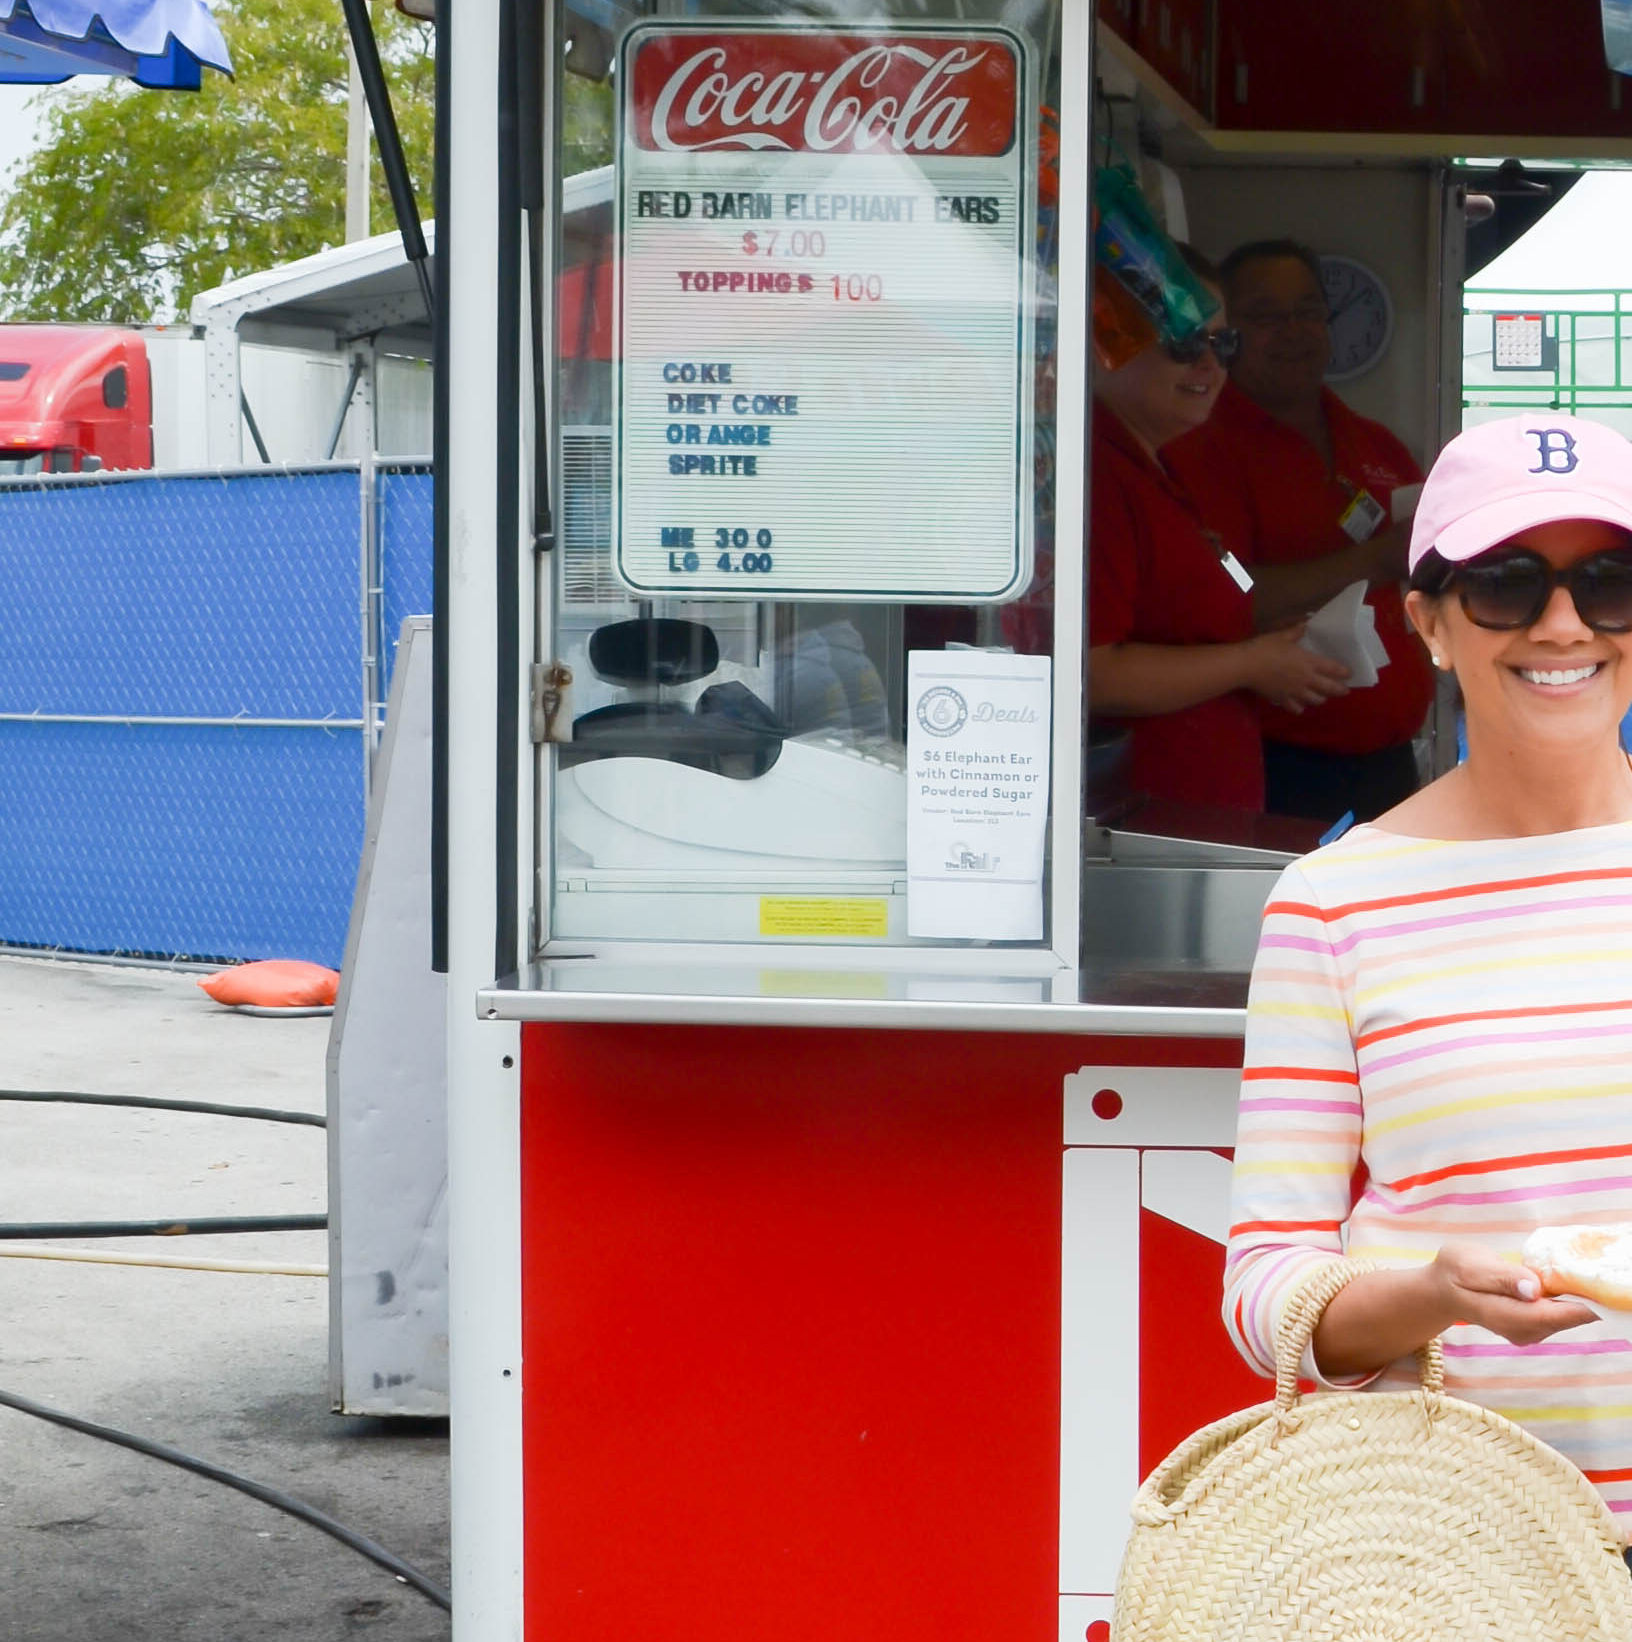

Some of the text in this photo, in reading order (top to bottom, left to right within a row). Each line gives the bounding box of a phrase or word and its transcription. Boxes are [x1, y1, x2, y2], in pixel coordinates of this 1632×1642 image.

[652, 45, 987, 152] Coca-Cola
[638, 191, 1000, 223] RED BARN ELEPHANT EARS
[742, 230, 825, 257] $7.00
[678, 271, 813, 294] TOPPINGS
[663, 362, 732, 384] COKE
[667, 393, 799, 416] DIET COKE
[1526, 429, 1579, 474] B
[668, 454, 757, 476] SPRITE
[669, 551, 772, 573] LG 4.00
[971, 702, 1039, 724] Deals
[923, 750, 1032, 766] $6 Elephant Ear
[916, 767, 1039, 782] with Cinnamon or
[921, 785, 1033, 802] Powdered Sugar
